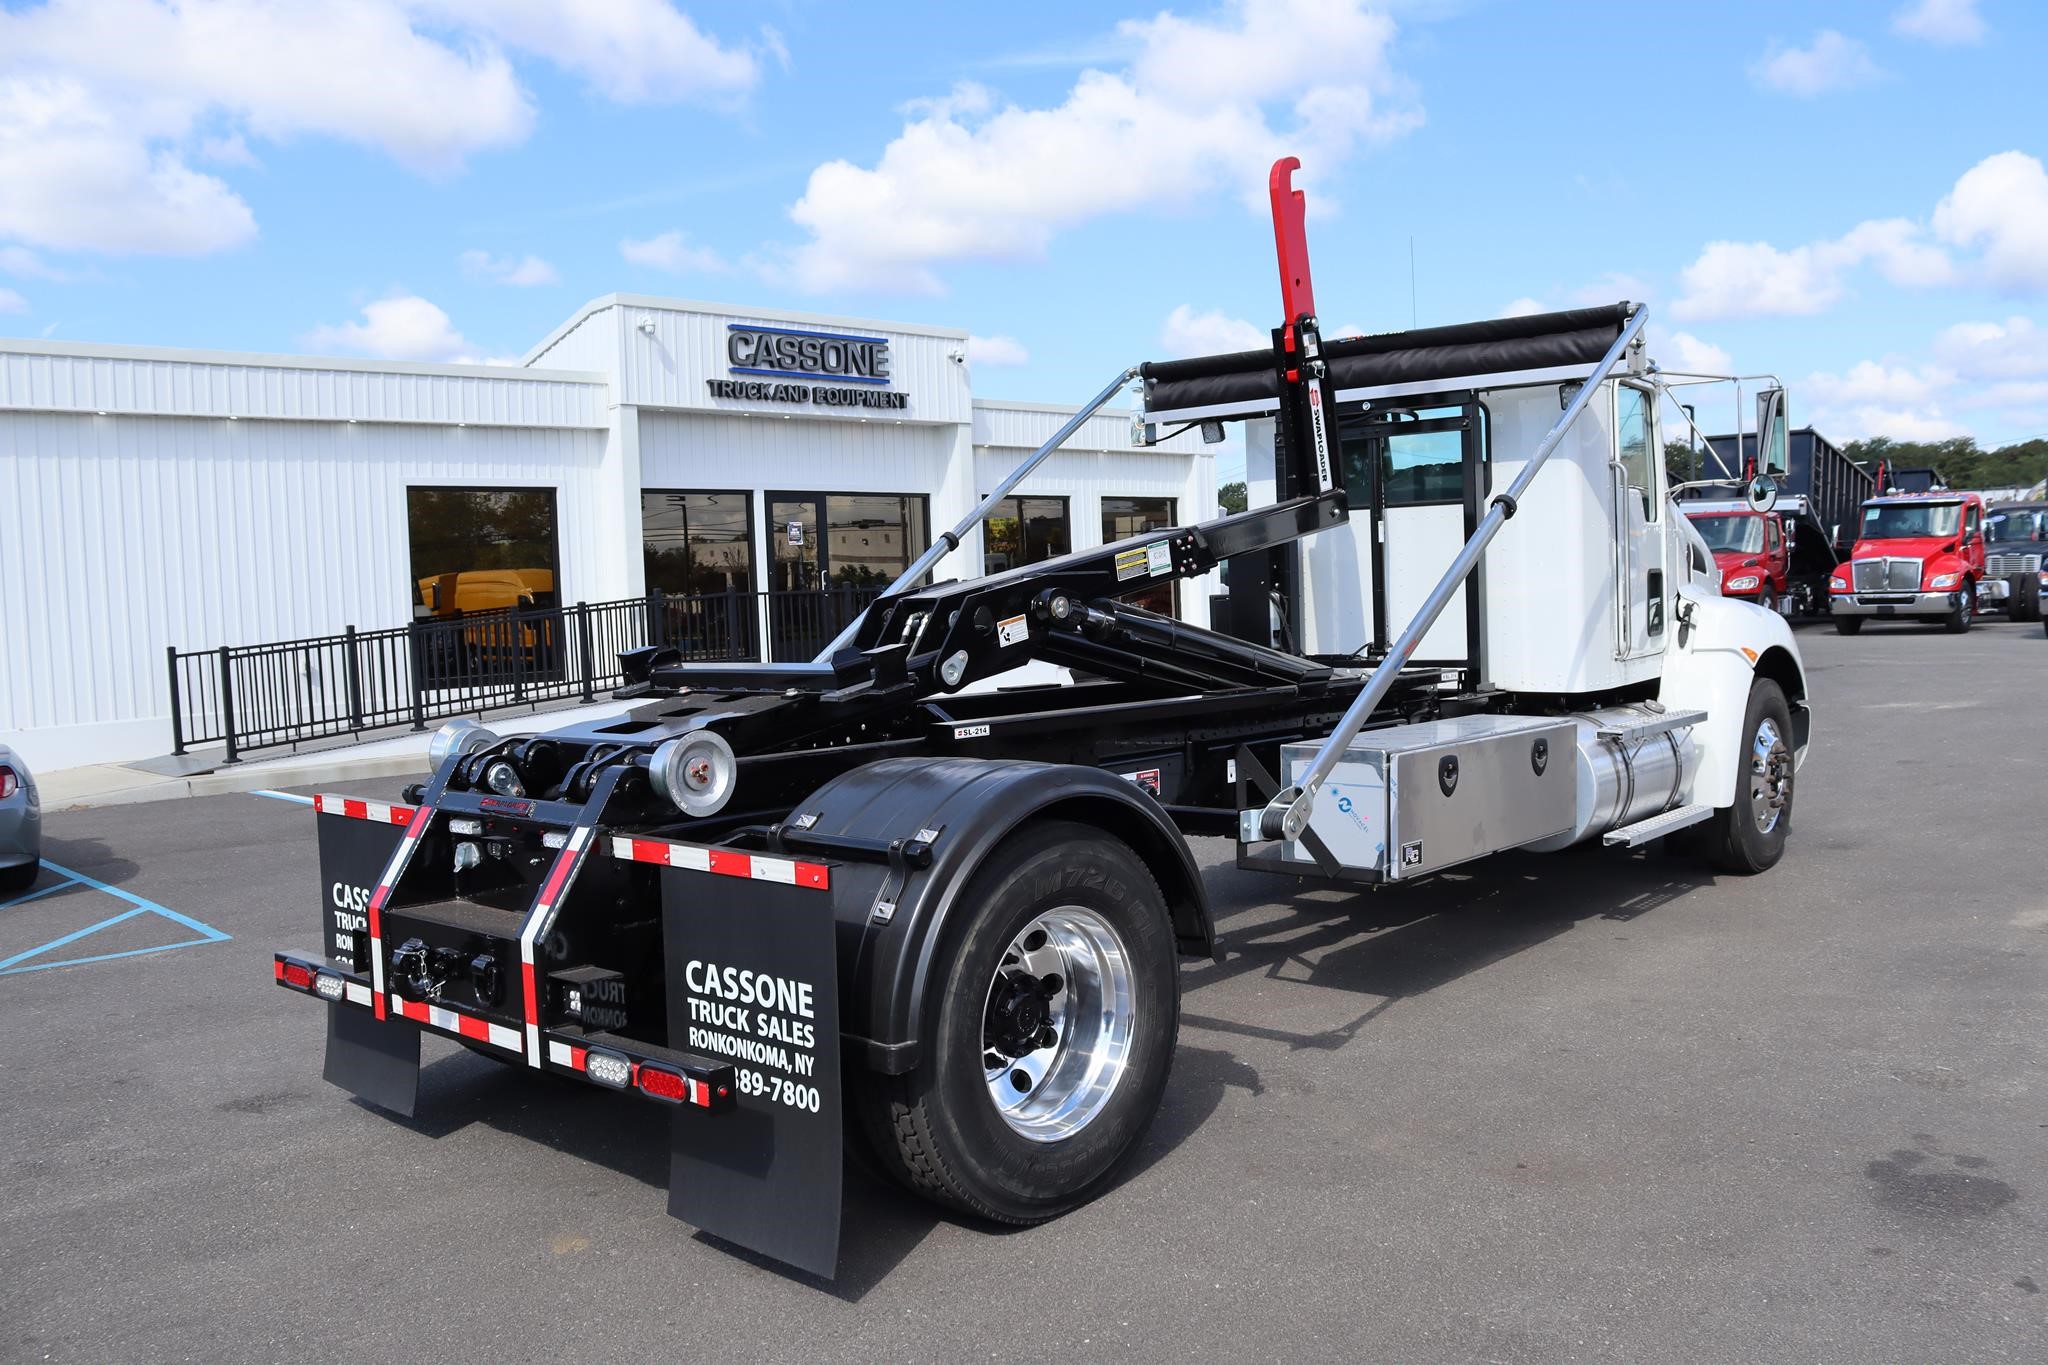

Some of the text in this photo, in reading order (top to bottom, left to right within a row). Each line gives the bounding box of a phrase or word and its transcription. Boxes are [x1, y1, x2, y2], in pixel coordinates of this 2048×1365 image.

[728, 332, 890, 376] CASSONE
[706, 378, 910, 409] TRUCK AND EQUIPMENT
[1314, 409, 1328, 482] SWAPLOADER
[963, 727, 987, 736] SL-214
[685, 960, 814, 1018] CASSONE
[687, 997, 815, 1048] TRUCK SALES
[689, 1026, 814, 1076] RONKONKOMA, NY
